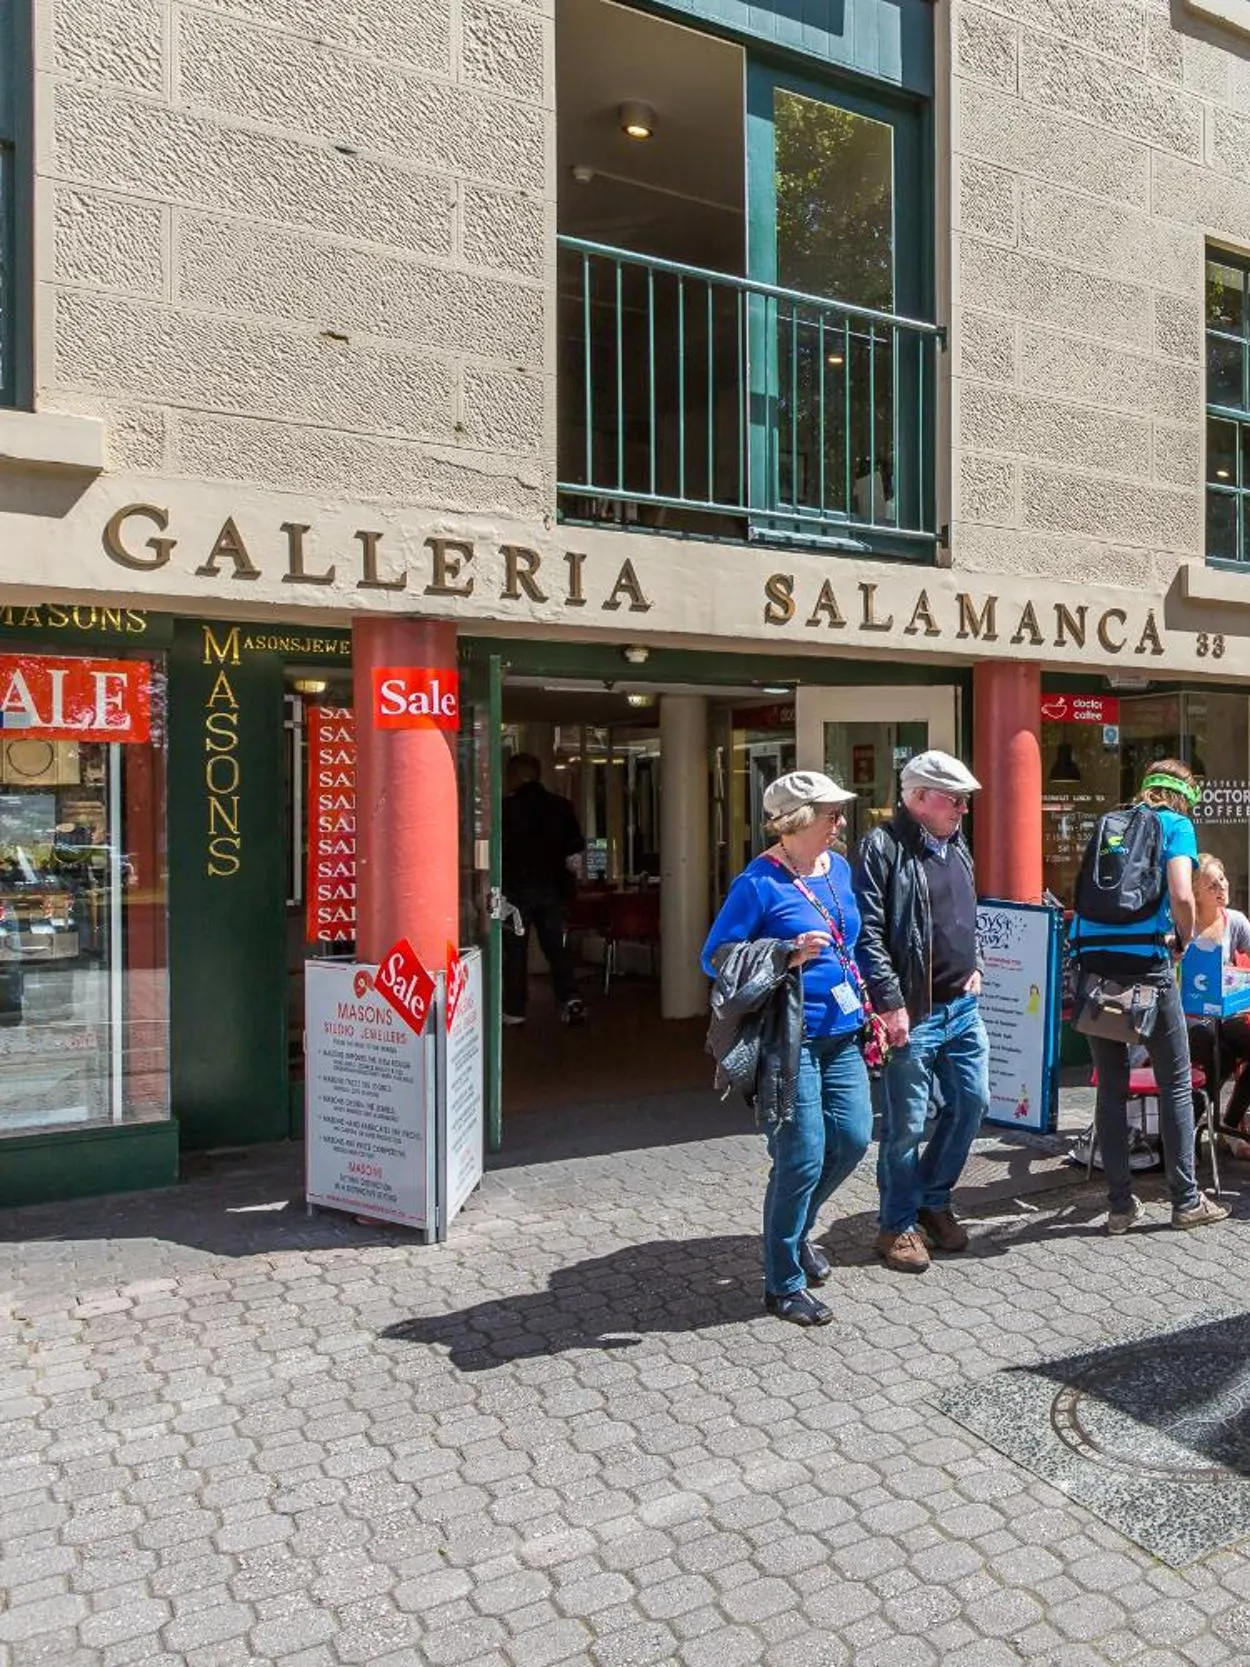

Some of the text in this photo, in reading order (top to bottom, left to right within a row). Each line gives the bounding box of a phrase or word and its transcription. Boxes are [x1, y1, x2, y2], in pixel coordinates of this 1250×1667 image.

[102, 502, 1226, 659] GALLERIA SALAMANCA 33
[1, 668, 132, 731] ALE
[380, 679, 457, 717] Sale
[1073, 698, 1103, 710] doctor
[1073, 711, 1103, 722] coffee
[203, 624, 241, 877] MASONS
[381, 952, 424, 1020] Sale
[337, 1002, 393, 1026] MASONS
